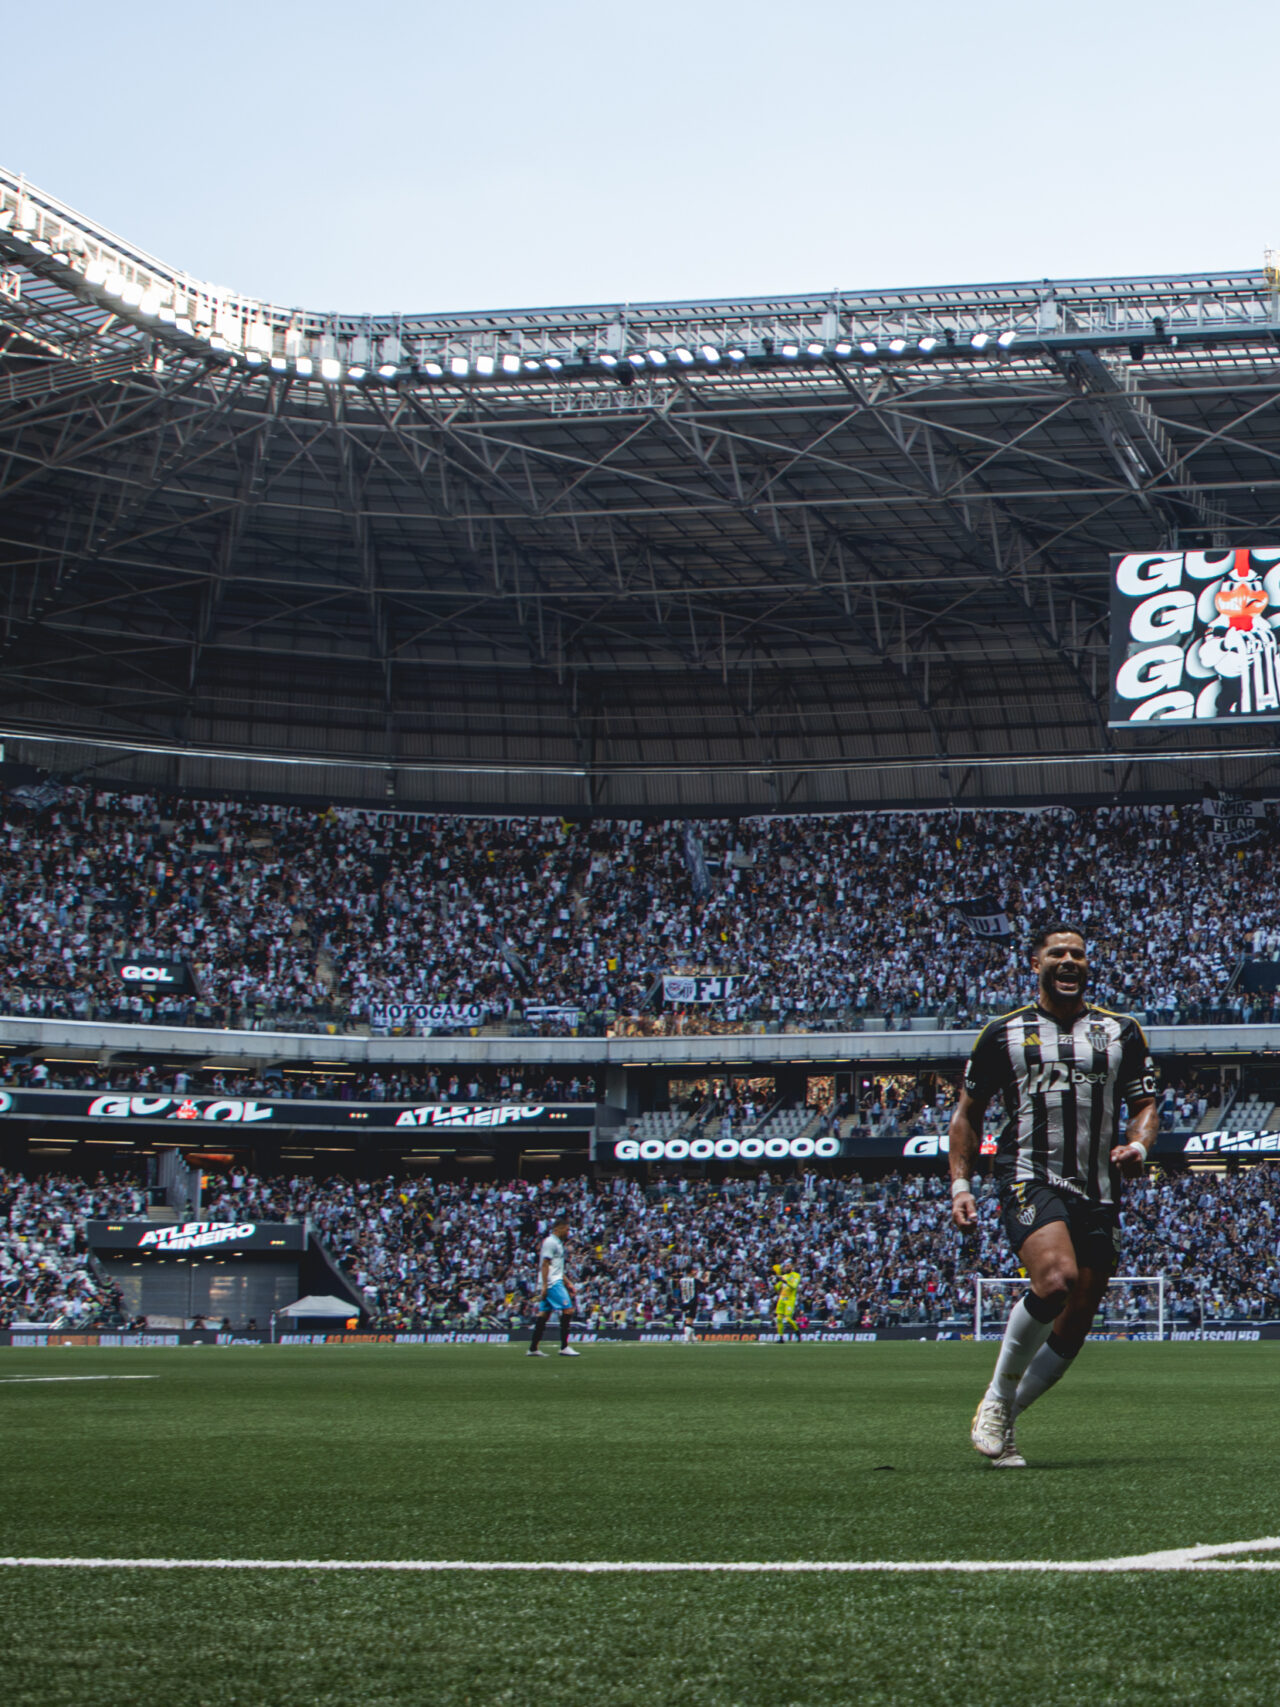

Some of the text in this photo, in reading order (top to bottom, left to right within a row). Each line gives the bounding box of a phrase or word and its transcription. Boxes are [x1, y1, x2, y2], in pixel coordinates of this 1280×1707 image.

[121, 965, 174, 982] GOL
[373, 1003, 482, 1019] MOTOGALO
[614, 1137, 841, 1160] GOOOOOOOO
